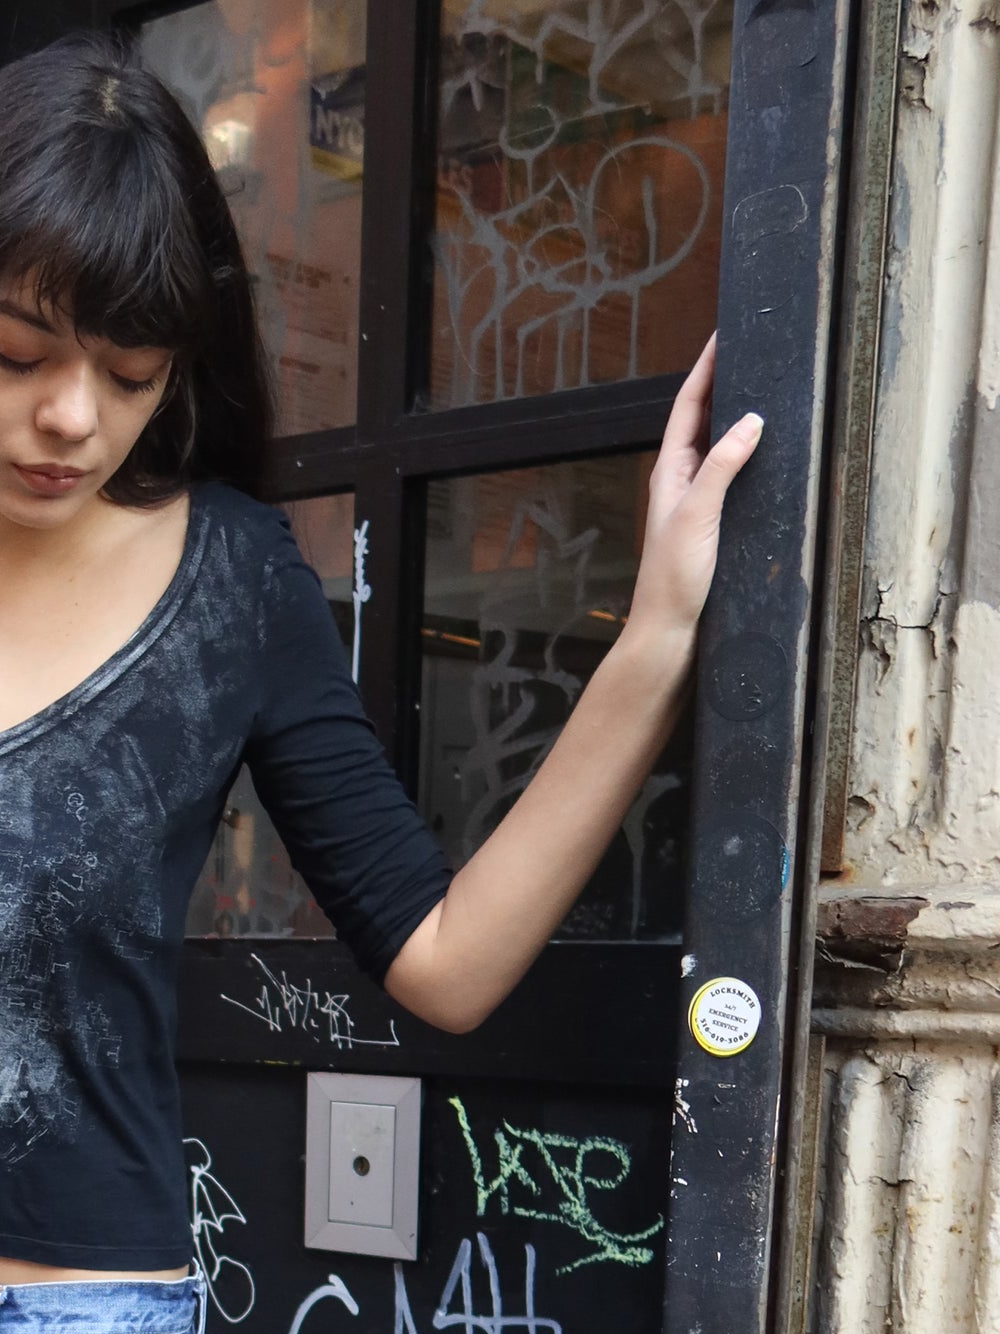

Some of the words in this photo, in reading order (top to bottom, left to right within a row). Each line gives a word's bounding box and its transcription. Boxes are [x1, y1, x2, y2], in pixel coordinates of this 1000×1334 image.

[710, 987, 756, 1009] LOCKSMITH
[708, 1008, 748, 1025] EMERGENCY
[712, 1019, 739, 1032] SERVICE
